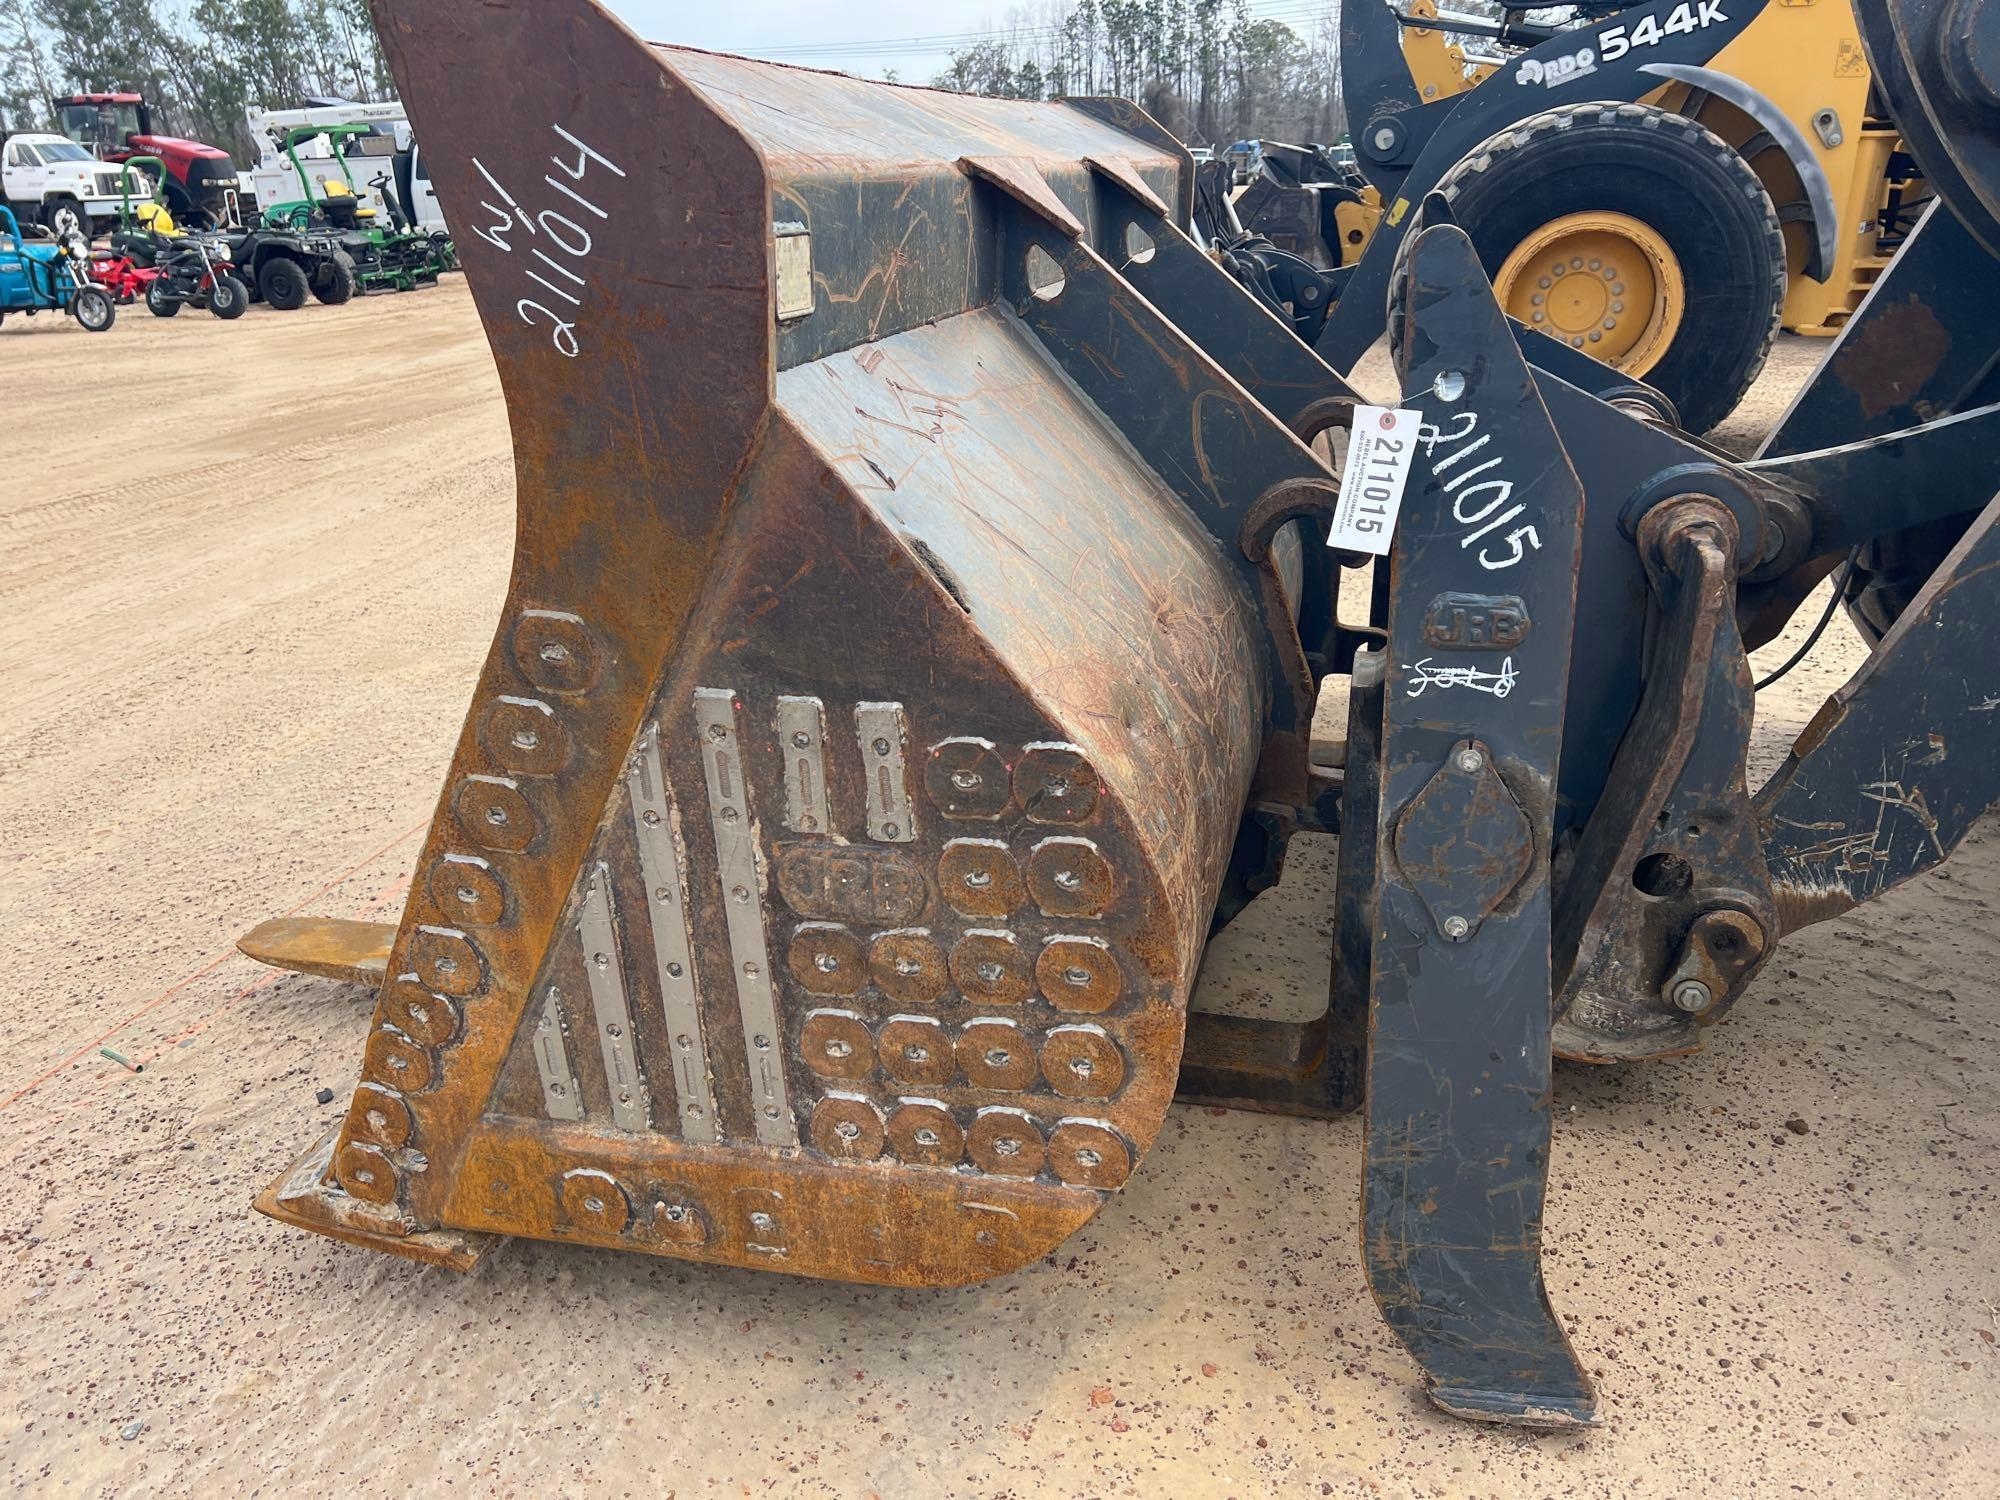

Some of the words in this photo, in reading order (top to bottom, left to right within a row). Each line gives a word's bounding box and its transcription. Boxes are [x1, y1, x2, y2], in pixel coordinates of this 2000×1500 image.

[1599, 0, 1729, 62] 544K
[516, 123, 626, 358] 211014
[1355, 463, 1367, 493] AUCTION
[1362, 438, 1372, 462] REBEL
[1346, 494, 1359, 528] COMPANY
[1355, 437, 1404, 534] 211015
[1417, 411, 1543, 570] 211015
